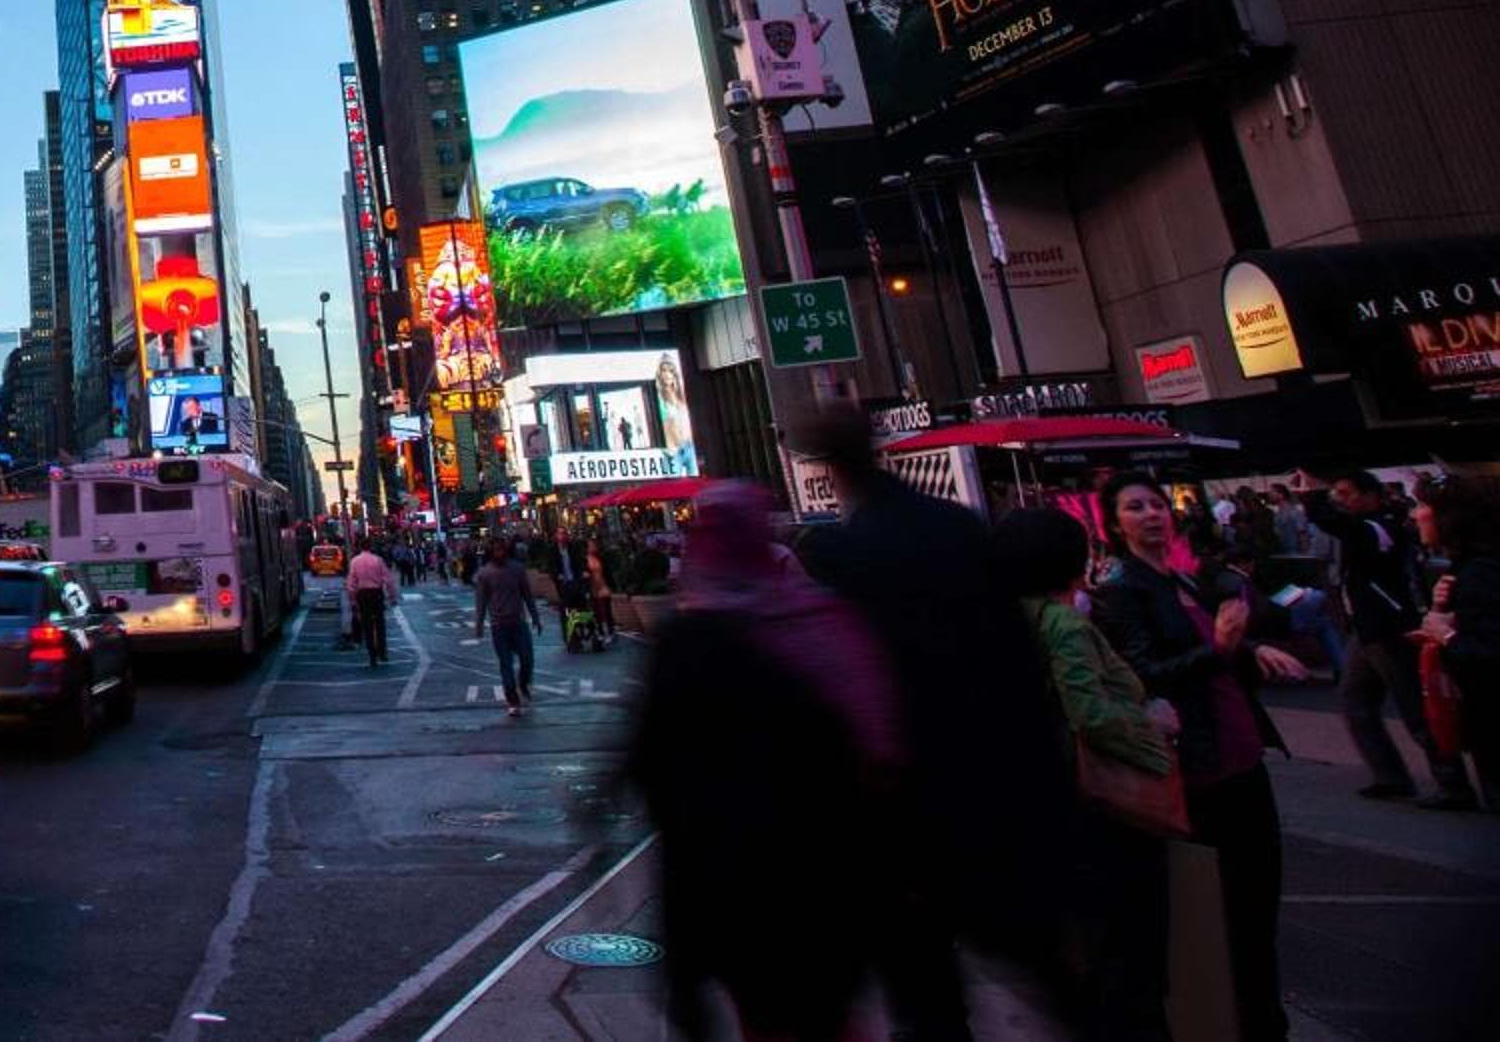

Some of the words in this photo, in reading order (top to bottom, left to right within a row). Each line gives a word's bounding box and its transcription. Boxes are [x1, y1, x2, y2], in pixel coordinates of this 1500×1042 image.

[967, 17, 1038, 61] DECEMBER
[1038, 6, 1055, 31] 13
[145, 88, 186, 105] TDK
[772, 315, 789, 333] W
[796, 311, 821, 329] 45
[825, 308, 847, 327] St
[902, 400, 931, 430] DOGS
[567, 455, 677, 479] AÉROPOSTALE
